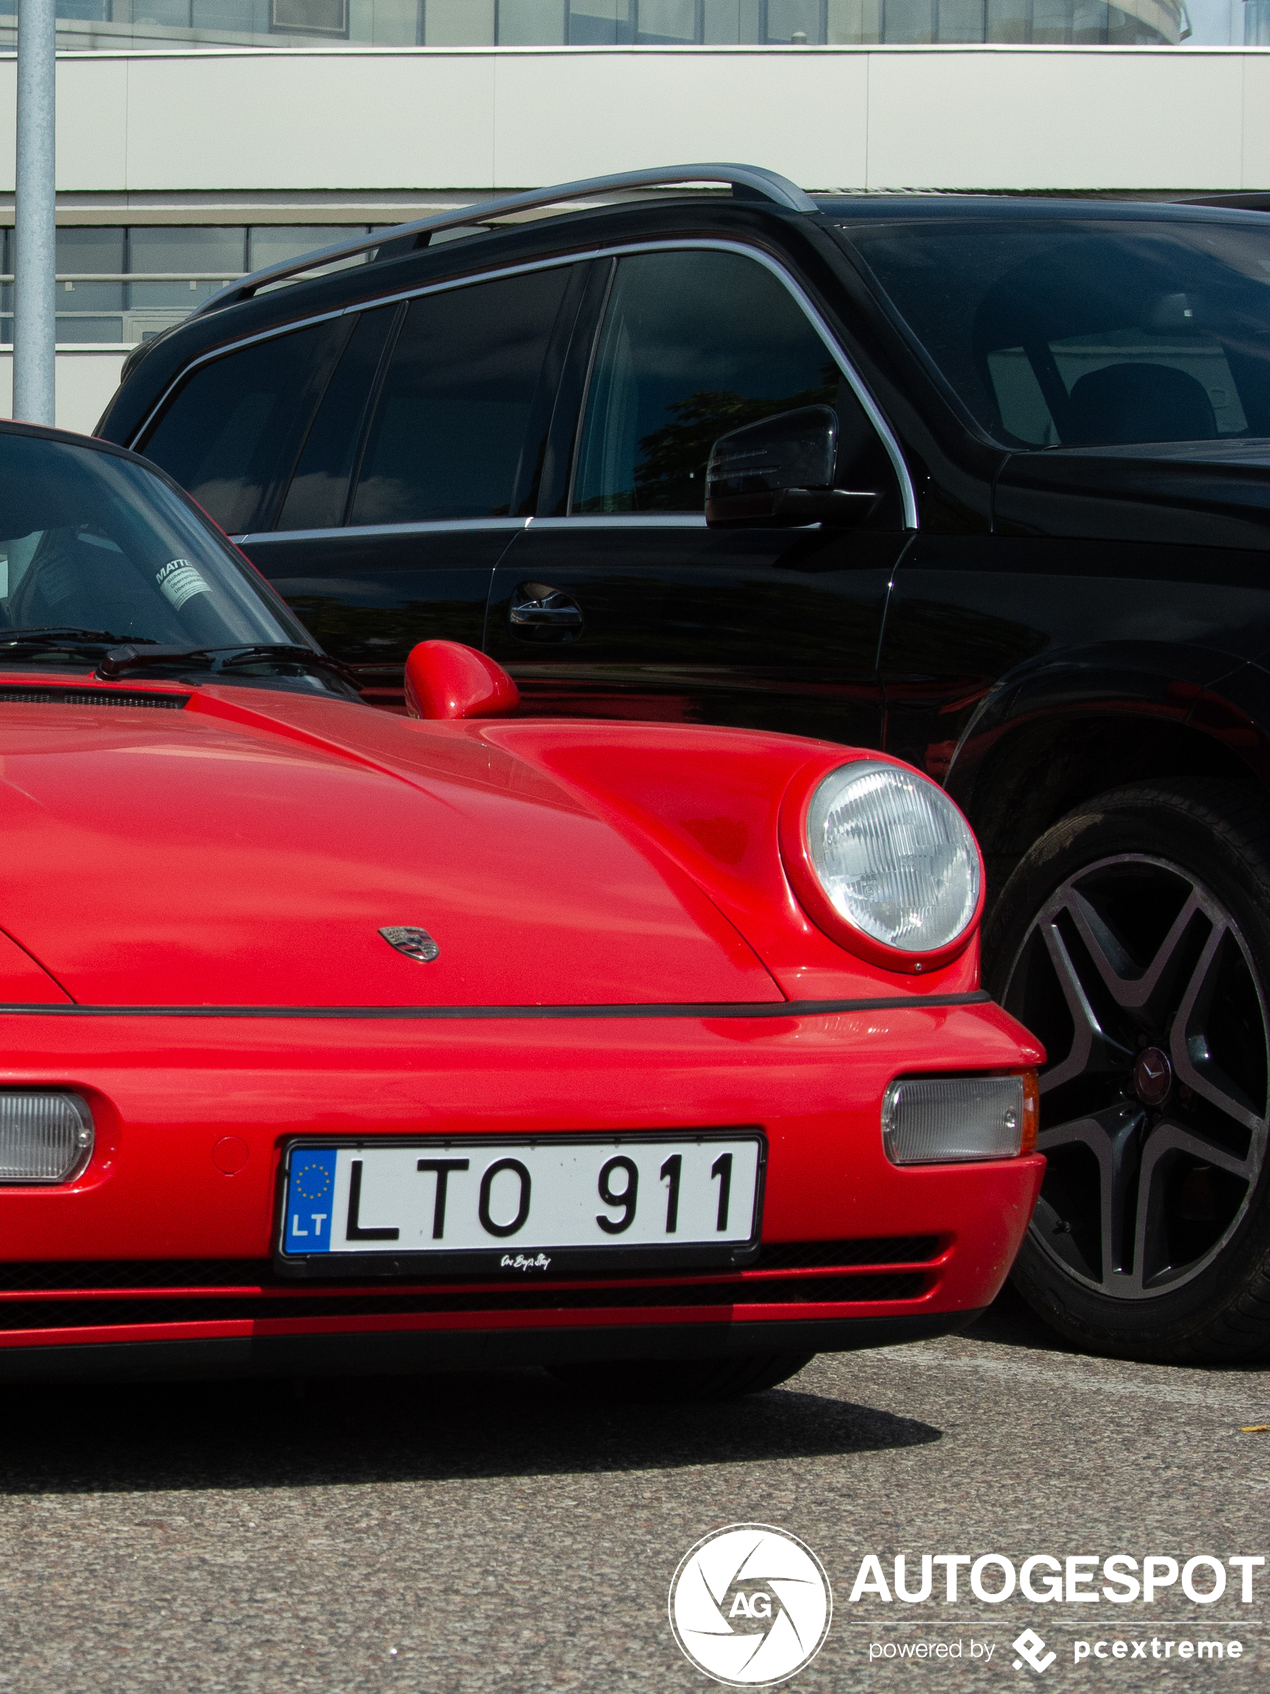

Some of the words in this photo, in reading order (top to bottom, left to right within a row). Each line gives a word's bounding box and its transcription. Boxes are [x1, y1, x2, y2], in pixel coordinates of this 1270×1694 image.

[345, 1157, 532, 1241] LTO
[595, 1152, 735, 1235] 911
[292, 1213, 328, 1237] LT
